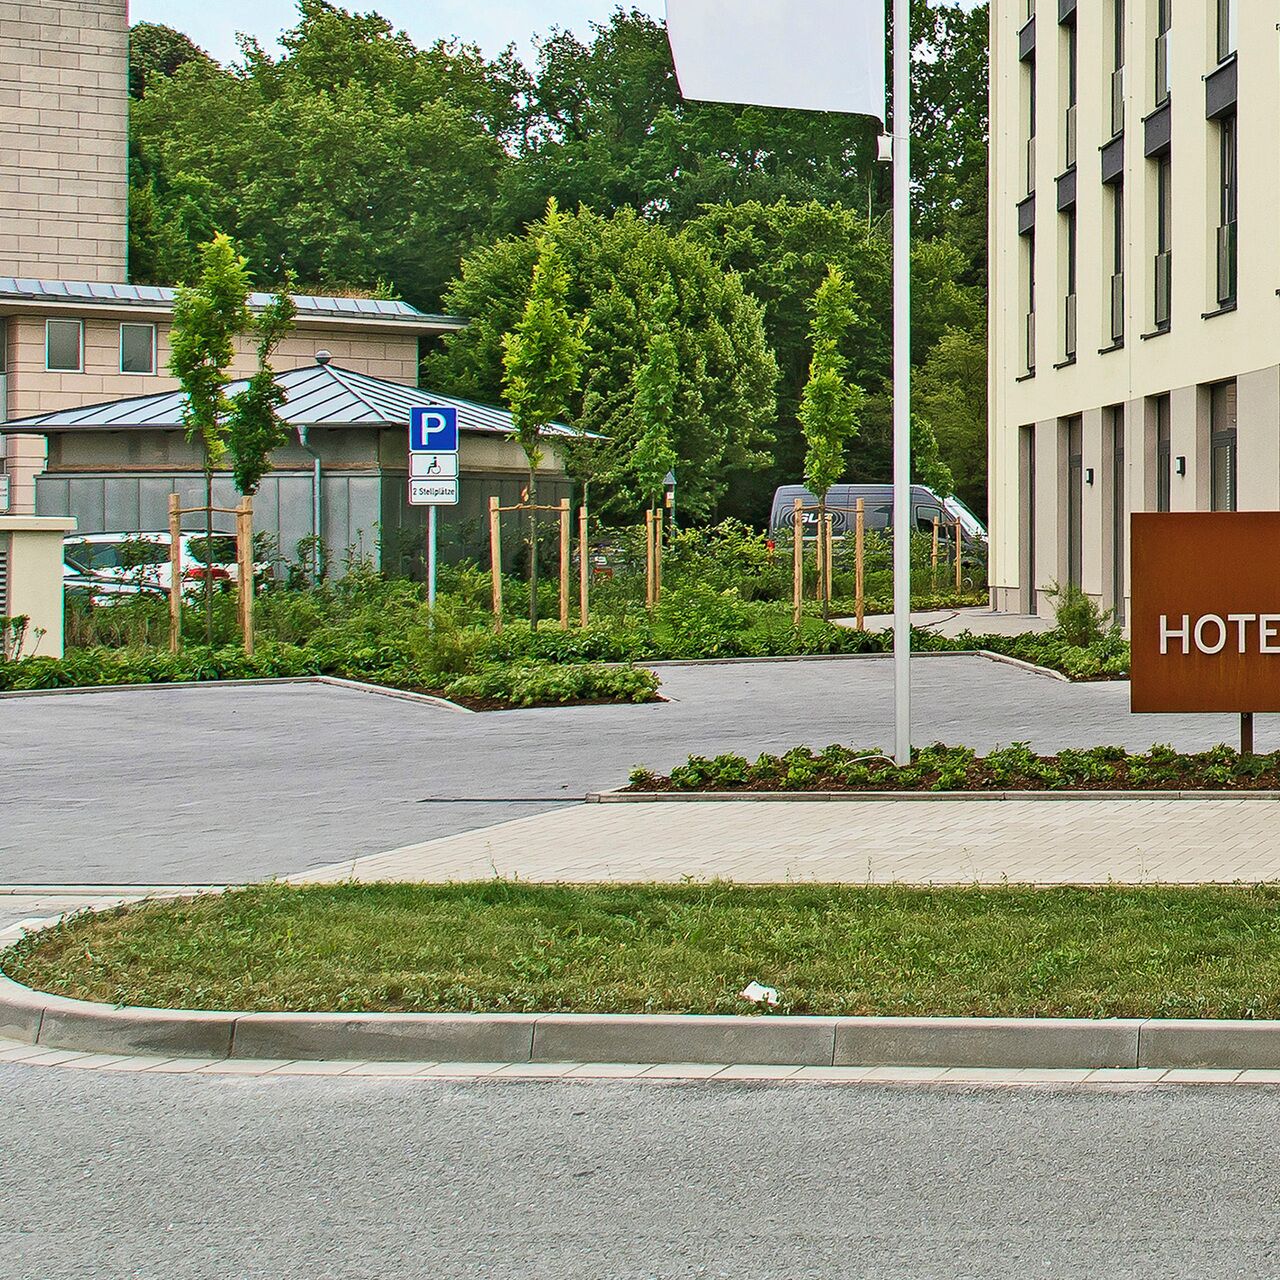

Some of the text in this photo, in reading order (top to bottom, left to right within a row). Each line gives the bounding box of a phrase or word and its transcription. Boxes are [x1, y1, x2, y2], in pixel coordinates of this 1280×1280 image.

[421, 412, 447, 447] P
[412, 486, 456, 497] 2 Stellplätze
